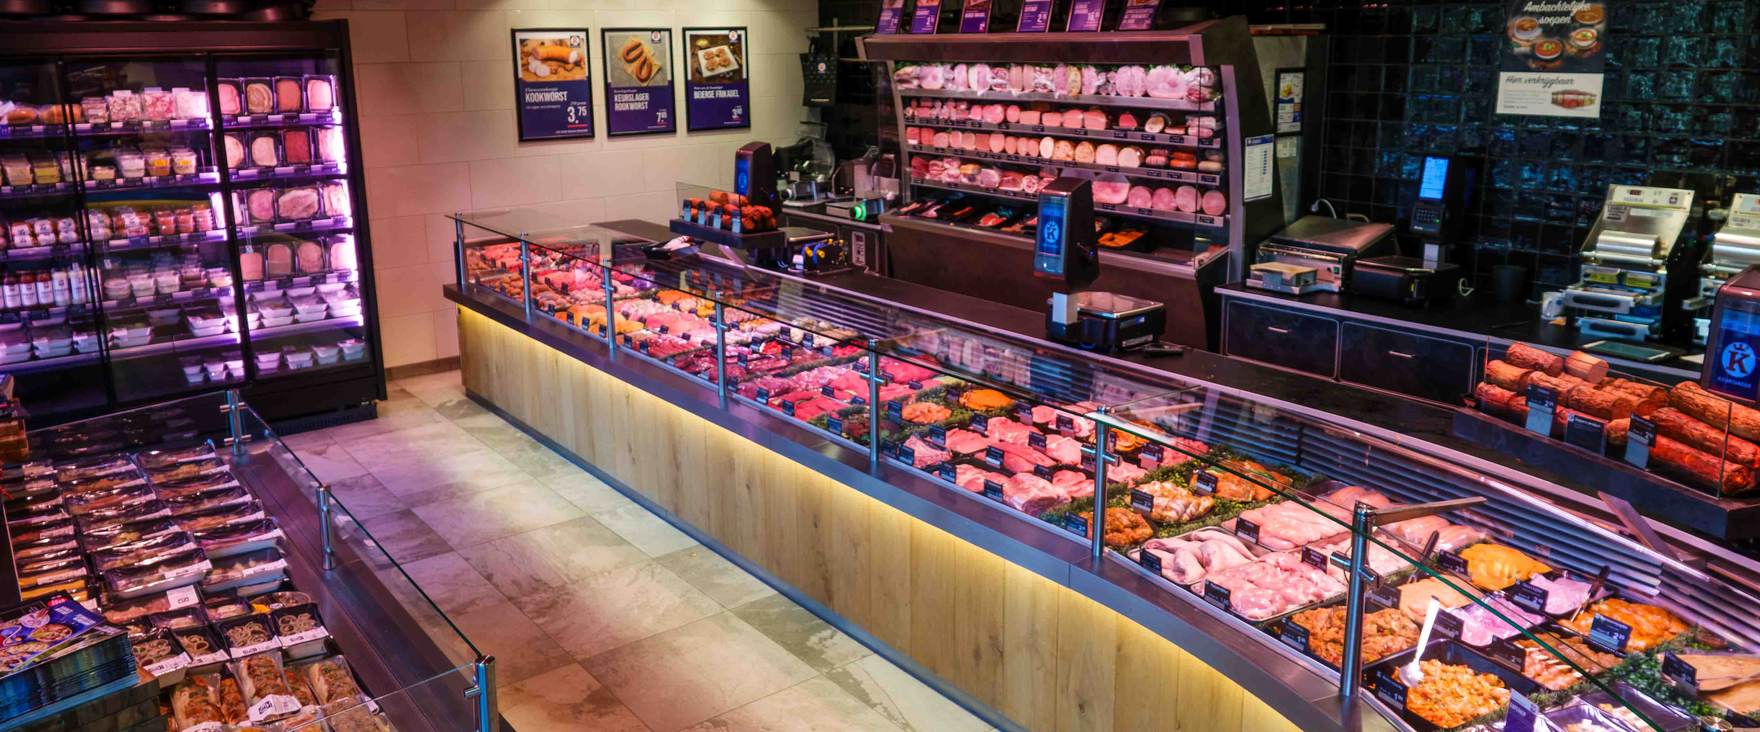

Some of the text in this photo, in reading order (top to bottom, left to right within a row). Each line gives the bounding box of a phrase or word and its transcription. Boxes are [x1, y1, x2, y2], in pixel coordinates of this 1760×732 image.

[1524, 0, 1592, 16] Ambachtelijke
[1536, 16, 1572, 26] soepen
[1505, 75, 1522, 84] Hier
[525, 91, 568, 103] KOOKWORST
[614, 92, 650, 102] KEURSLAGER
[715, 89, 740, 98] FRIKADEL
[614, 101, 648, 111] ROOKWORST
[1727, 350, 1751, 374] K
